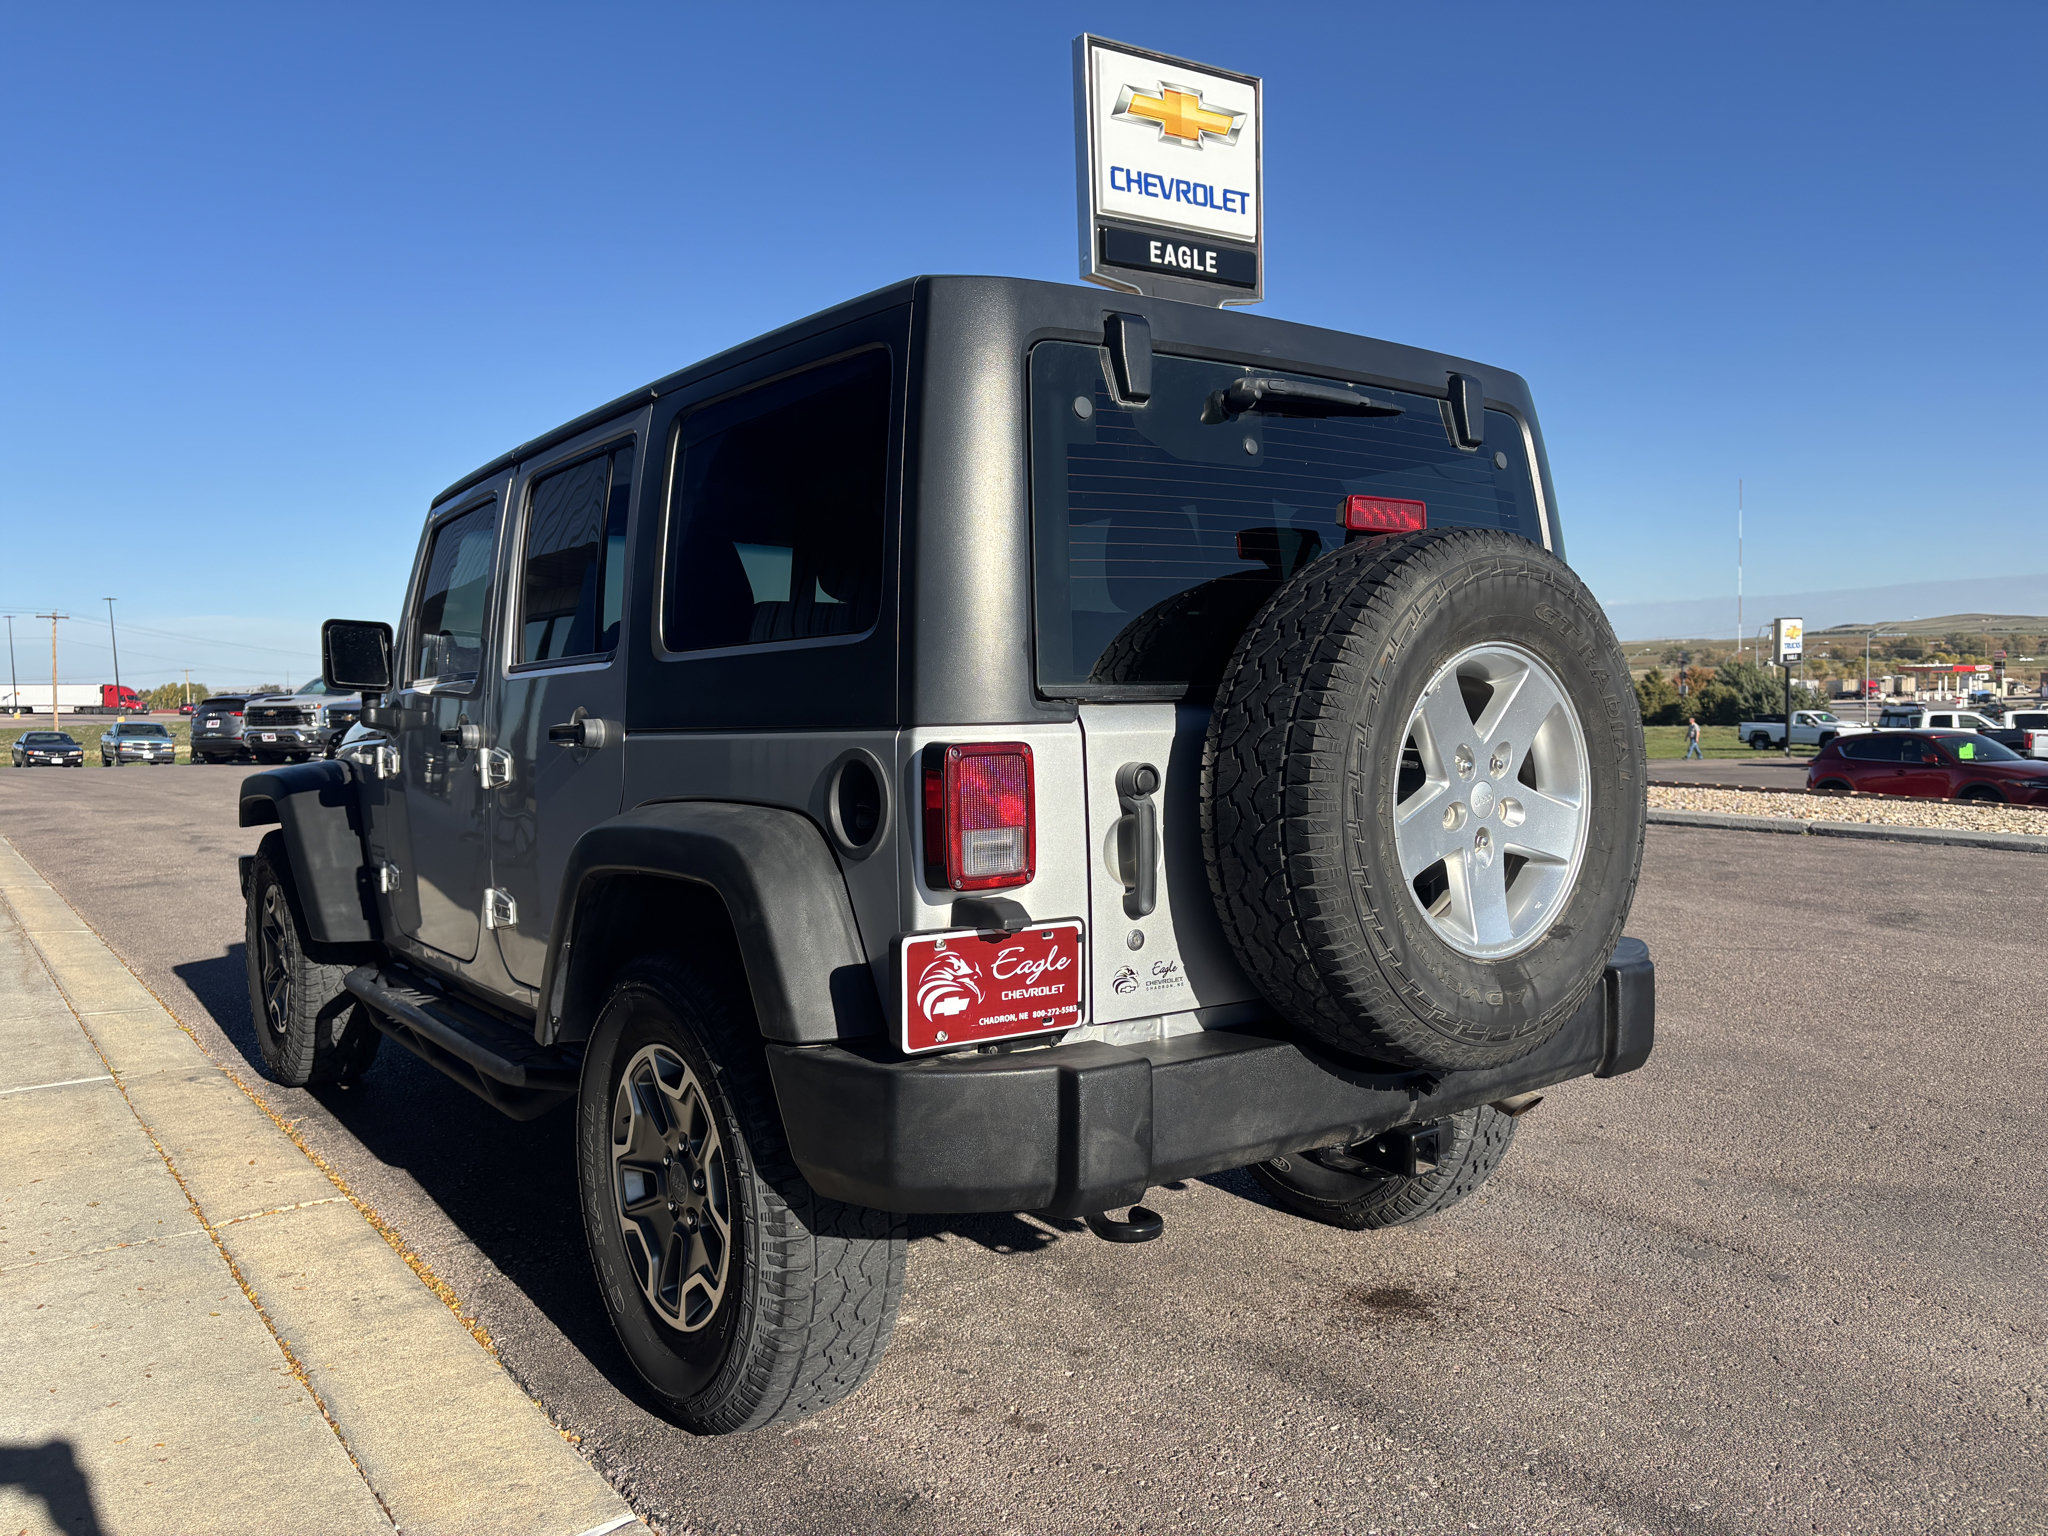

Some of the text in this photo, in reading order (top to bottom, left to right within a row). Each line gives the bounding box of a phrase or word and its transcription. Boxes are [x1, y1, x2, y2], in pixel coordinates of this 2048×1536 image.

[1110, 165, 1250, 215] CHEVROLET
[1149, 240, 1218, 274] EAGLE
[1533, 601, 1634, 791] GT RADIAL
[990, 944, 1072, 985] Eagle
[1151, 960, 1179, 979] Eagle
[1001, 983, 1066, 1001] CHEVROLET
[978, 1013, 1018, 1026] CHADRON,
[1018, 1011, 1029, 1020] NE
[583, 1102, 625, 1314] GT RADIAL
